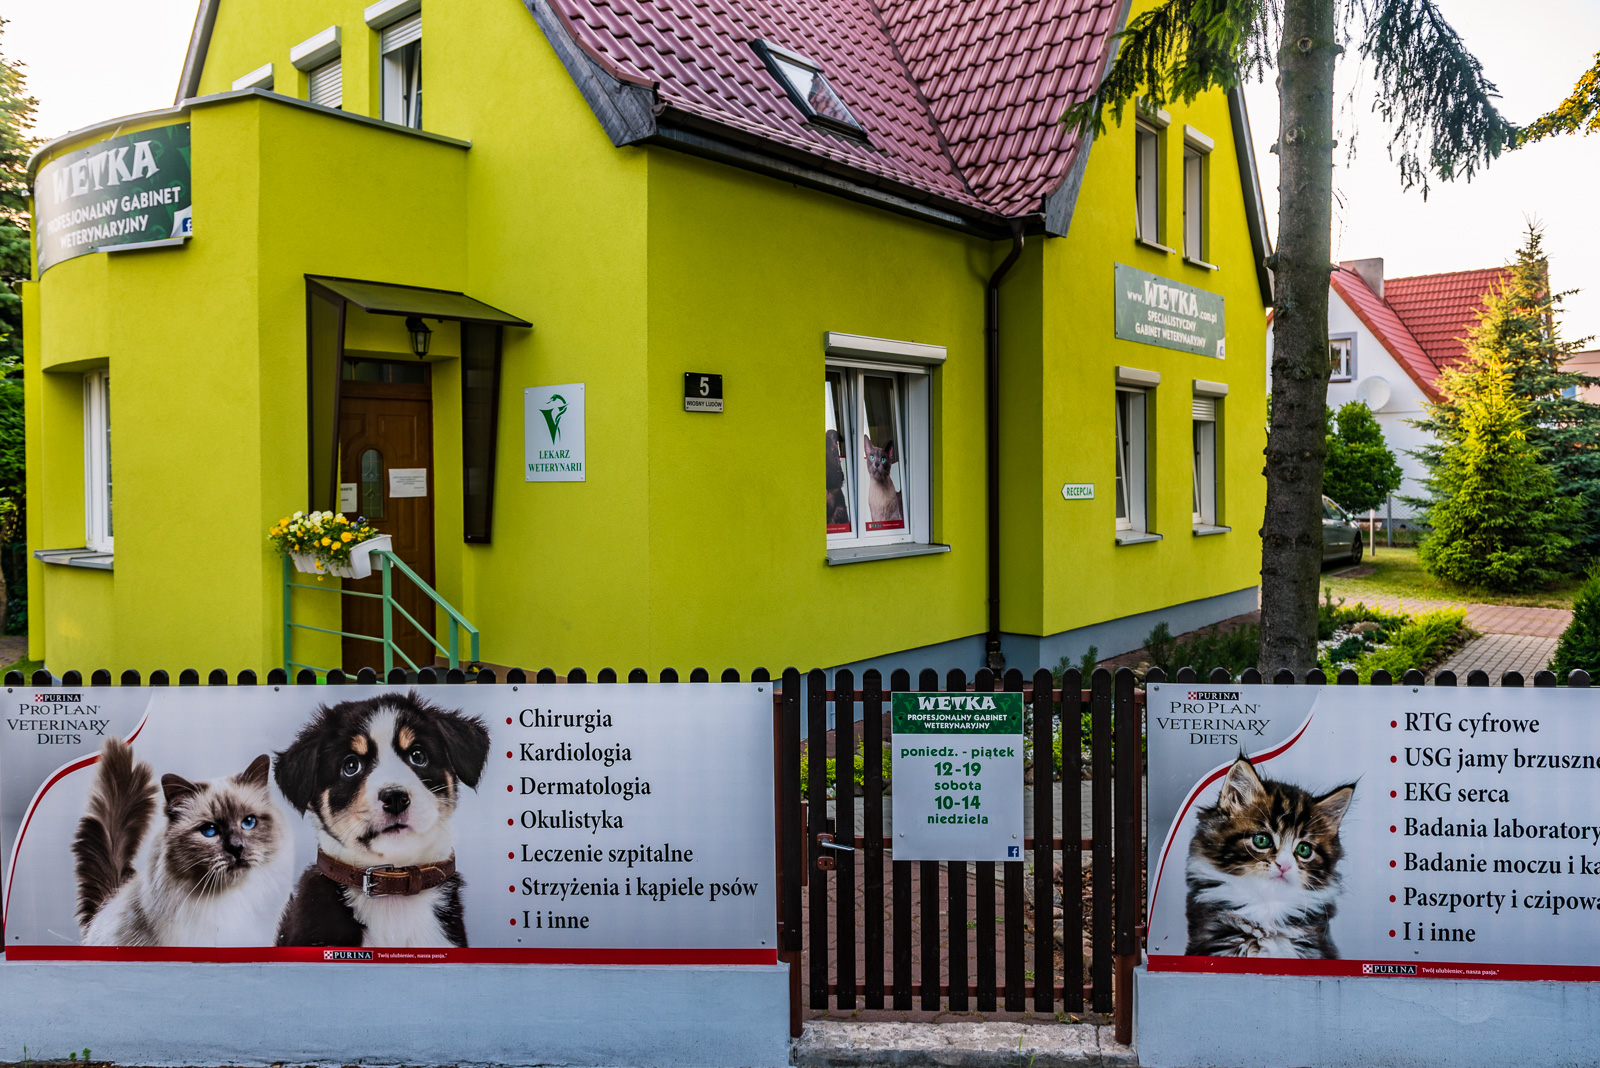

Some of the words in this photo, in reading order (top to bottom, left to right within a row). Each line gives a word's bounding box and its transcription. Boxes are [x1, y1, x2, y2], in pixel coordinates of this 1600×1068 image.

[52, 140, 160, 204] WETKA
[47, 198, 118, 236] PROFESJONALNY
[121, 186, 181, 212] GABINET
[59, 214, 149, 249] WETERYNARYJNY
[1147, 310, 1197, 332] SPECJALISTYCZNY
[1135, 322, 1161, 338] GABINET
[1162, 328, 1206, 348] WETERYNARYJNY
[700, 376, 710, 396] 5
[539, 450, 570, 460] LEKARZ
[528, 462, 582, 472] WETERYNARII
[1066, 486, 1092, 497] RECEPCJA
[44, 694, 80, 702] PURINA
[918, 696, 996, 711] WETKA
[1198, 692, 1238, 700] PURINA
[519, 709, 613, 733] Chirurgia
[1404, 712, 1452, 732] RTG
[1458, 712, 1540, 738] cyfrowe
[38, 734, 81, 744] DIETS
[1189, 733, 1238, 745] DIETS
[520, 742, 632, 767] Kardiologia
[901, 746, 958, 758] poniedz.
[972, 746, 1014, 759] piątek
[1405, 747, 1451, 767] USG
[1456, 748, 1508, 773] jamy
[520, 776, 652, 800] Dermatologia
[935, 780, 982, 790] sobota
[1404, 782, 1452, 802] EKG
[1457, 786, 1510, 802] serca
[520, 810, 624, 834] Okulistyka
[928, 814, 988, 824] niedziela
[1404, 818, 1488, 838] Badania
[521, 844, 603, 862] Leczenie
[608, 843, 694, 868] szpitalne
[1404, 852, 1487, 872] Badanie
[1492, 857, 1562, 874] moczu
[1567, 856, 1574, 874] i
[522, 877, 620, 902] Strzyżenia
[624, 878, 631, 896] i
[636, 876, 704, 902] kąpiele
[709, 877, 758, 902] psów
[1404, 886, 1506, 914] Paszporty
[1511, 890, 1518, 908] i
[522, 910, 530, 928] I
[536, 911, 542, 928] i
[548, 910, 590, 929] inne
[1403, 922, 1412, 940] I
[1417, 922, 1424, 940] i
[1430, 922, 1476, 942] inne
[1374, 965, 1415, 974] PURINA
